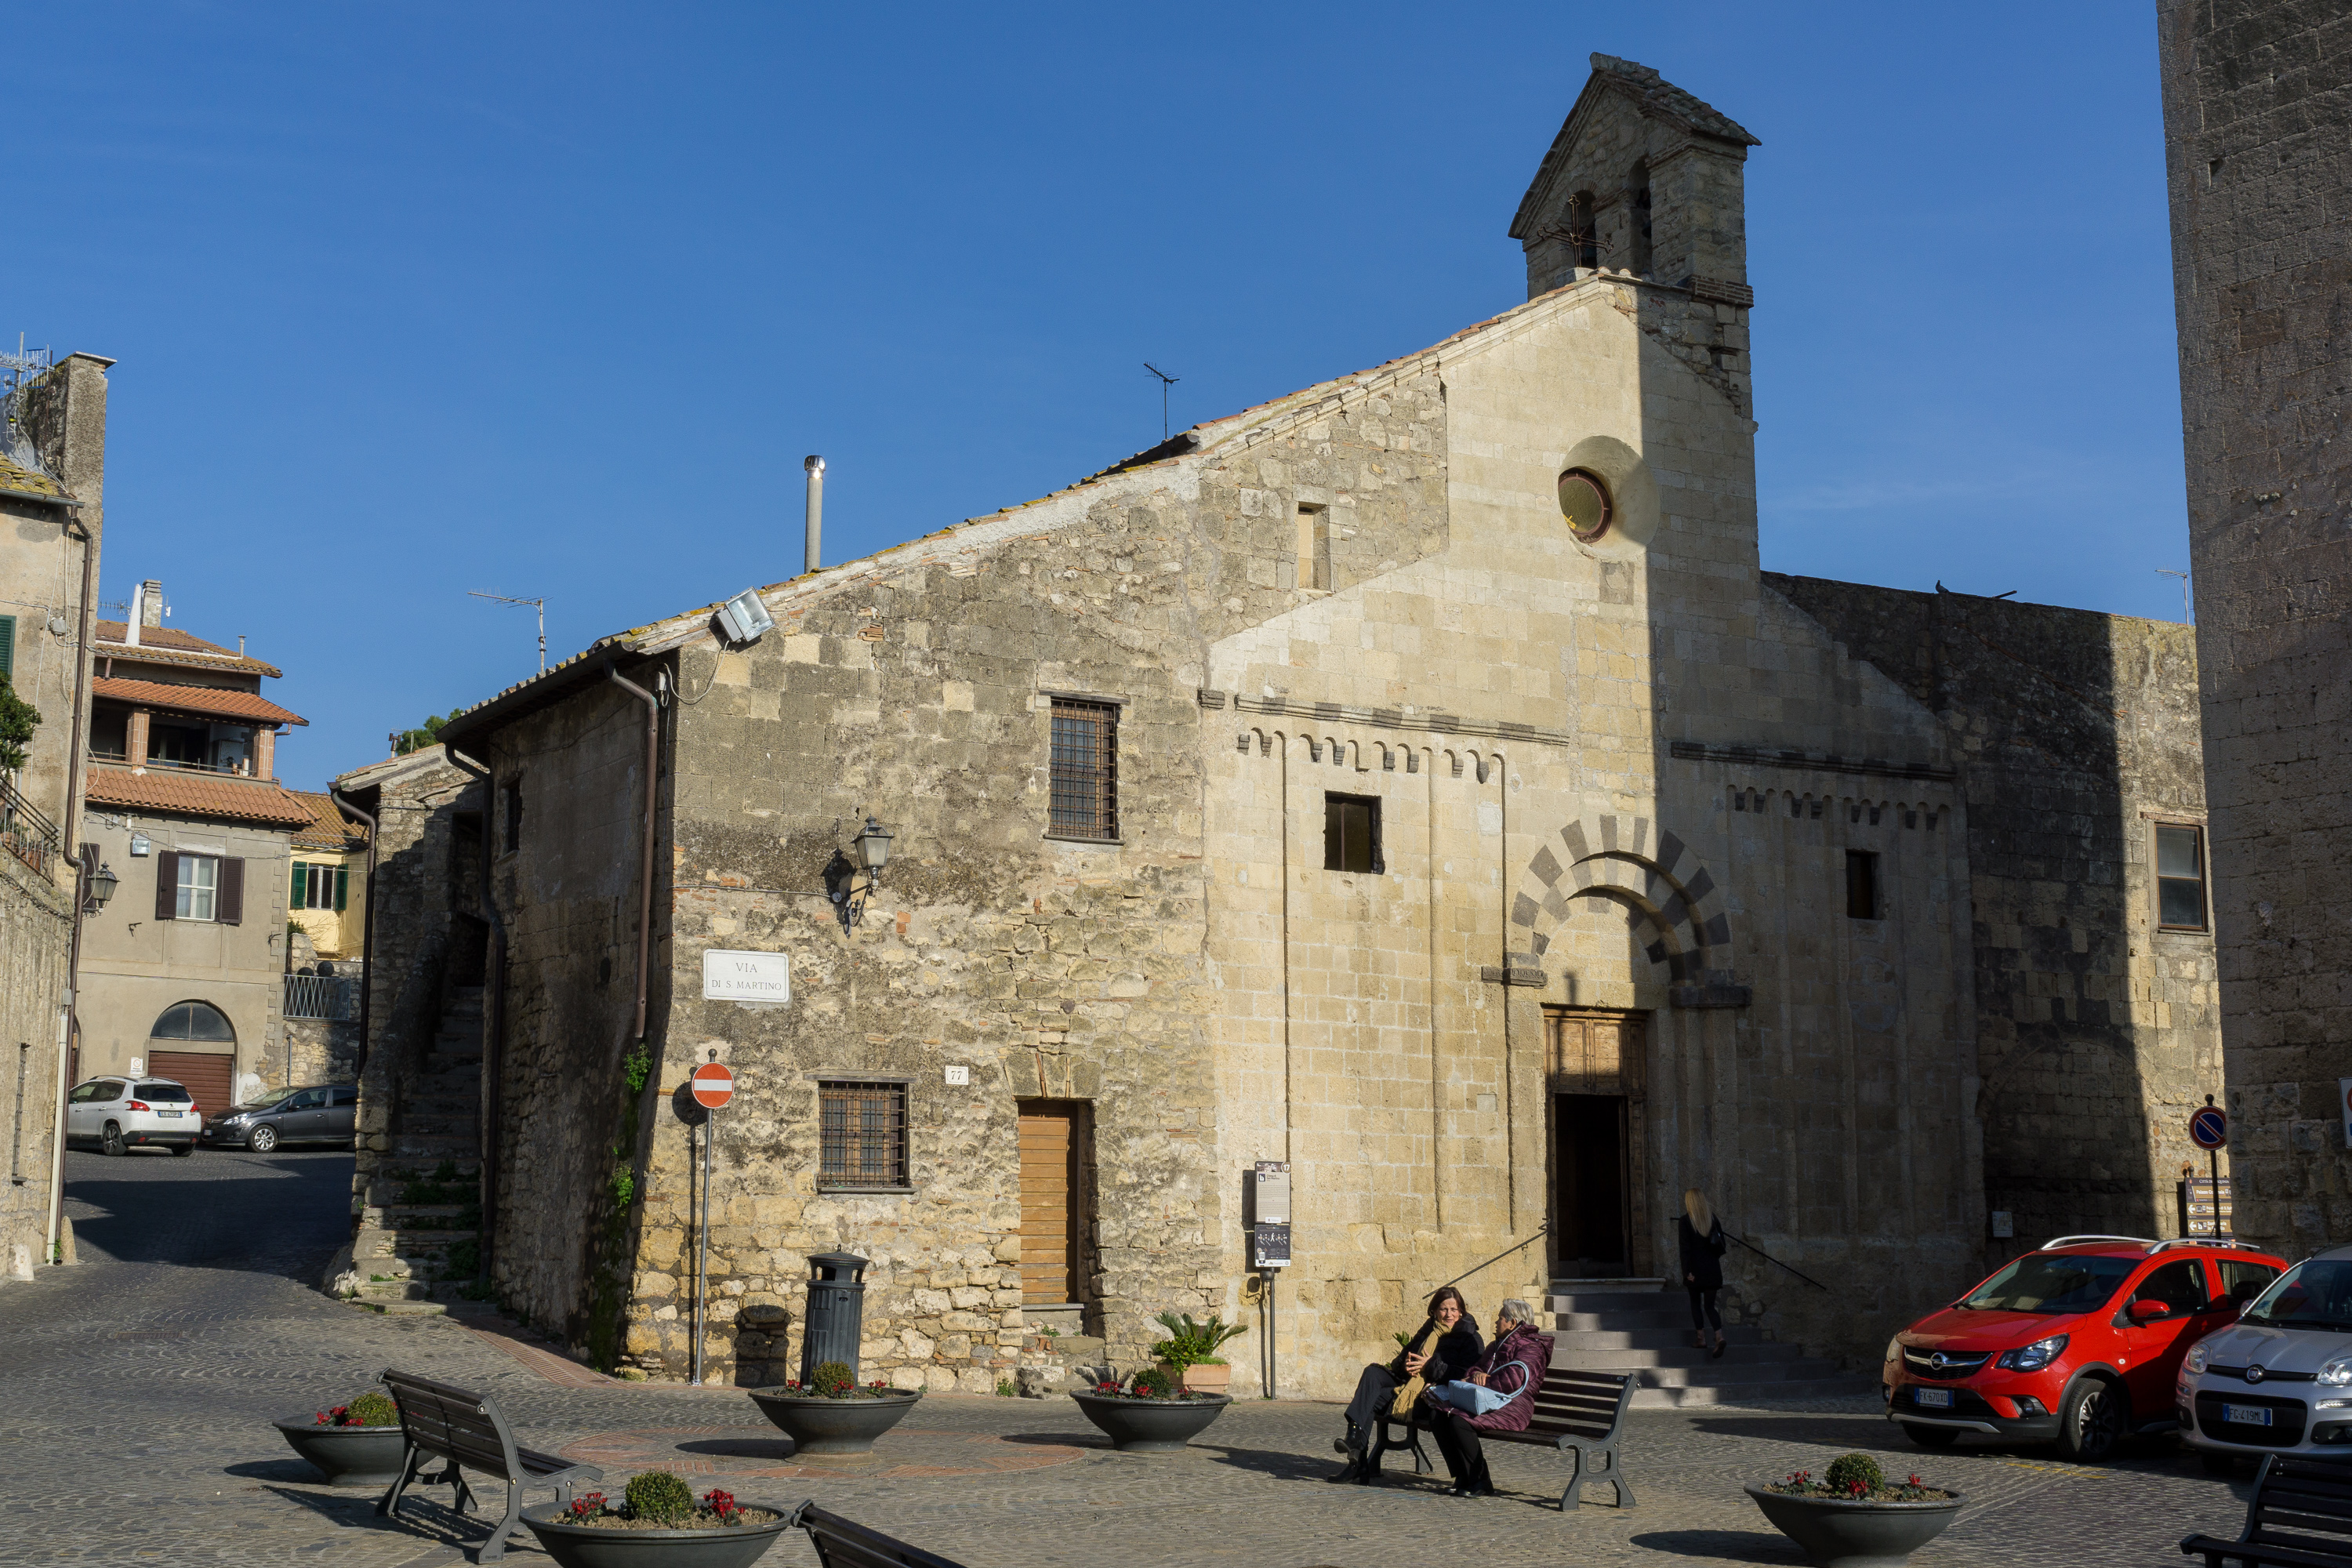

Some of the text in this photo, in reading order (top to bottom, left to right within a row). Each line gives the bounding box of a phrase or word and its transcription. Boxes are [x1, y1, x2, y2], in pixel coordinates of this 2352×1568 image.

[735, 963, 757, 973] VIA
[711, 979, 782, 991] DI S. MARTINO
[951, 1070, 963, 1080] 77
